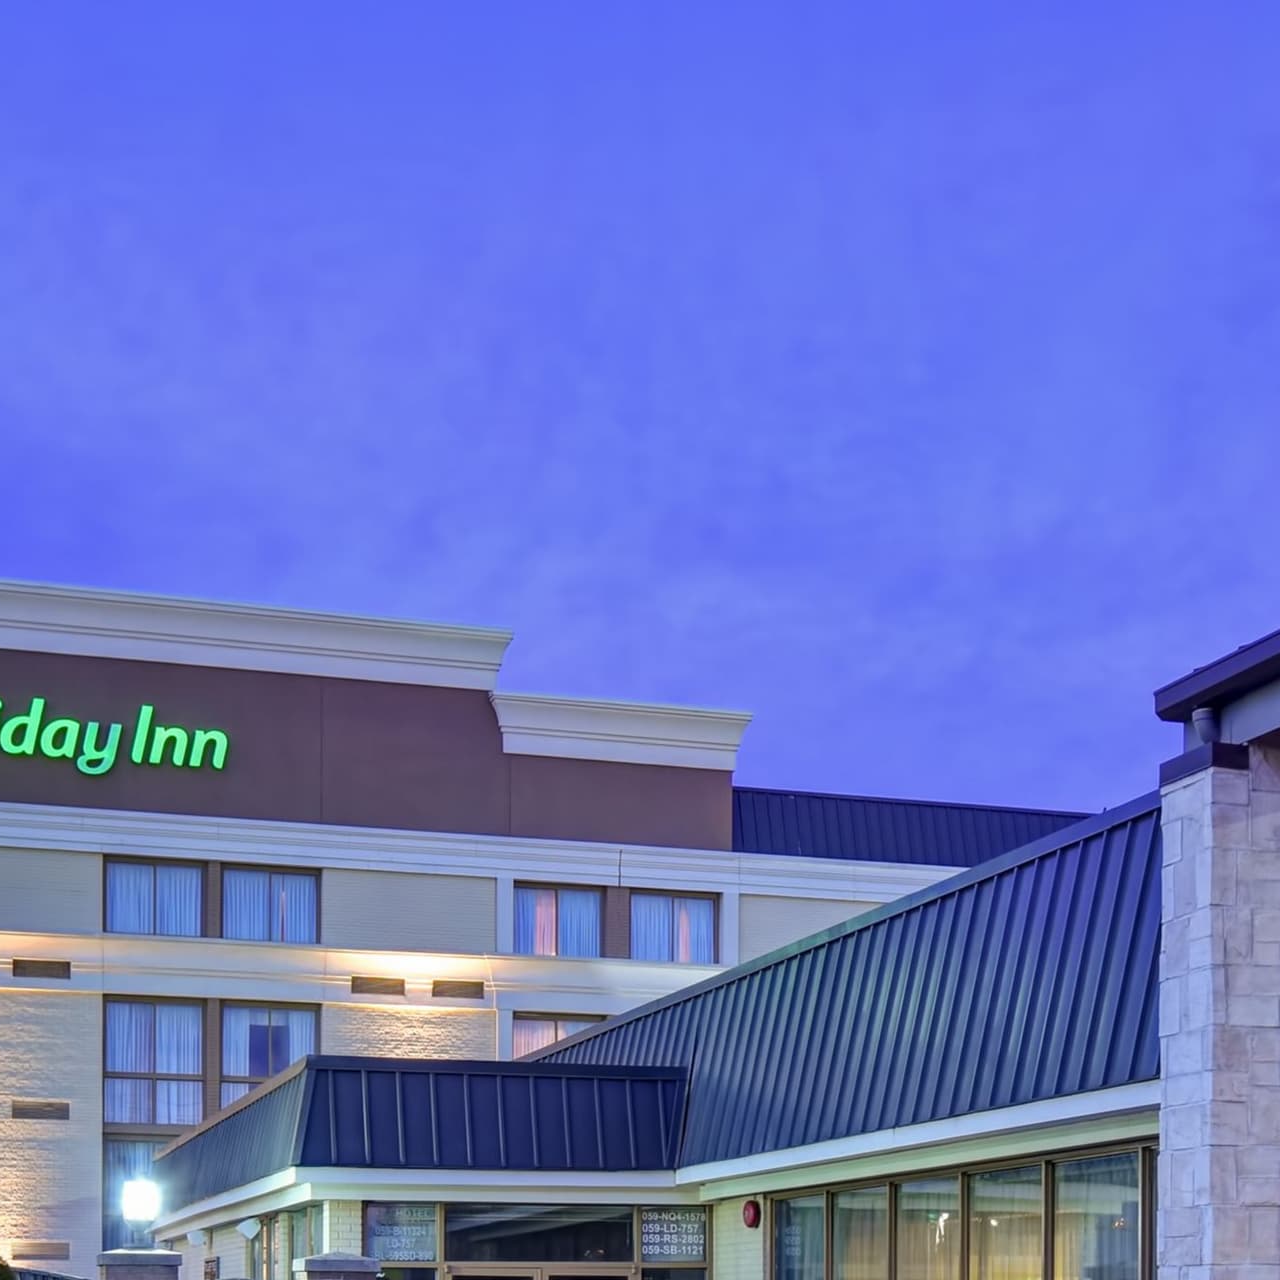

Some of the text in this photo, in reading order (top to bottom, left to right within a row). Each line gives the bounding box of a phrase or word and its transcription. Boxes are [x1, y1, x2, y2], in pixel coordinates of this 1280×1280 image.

[131, 706, 228, 769] Inn
[642, 1223, 699, 1233] 059-LD-757
[642, 1234, 705, 1243] 059-RS-2802
[642, 1245, 704, 1255] 059-SB-1121
